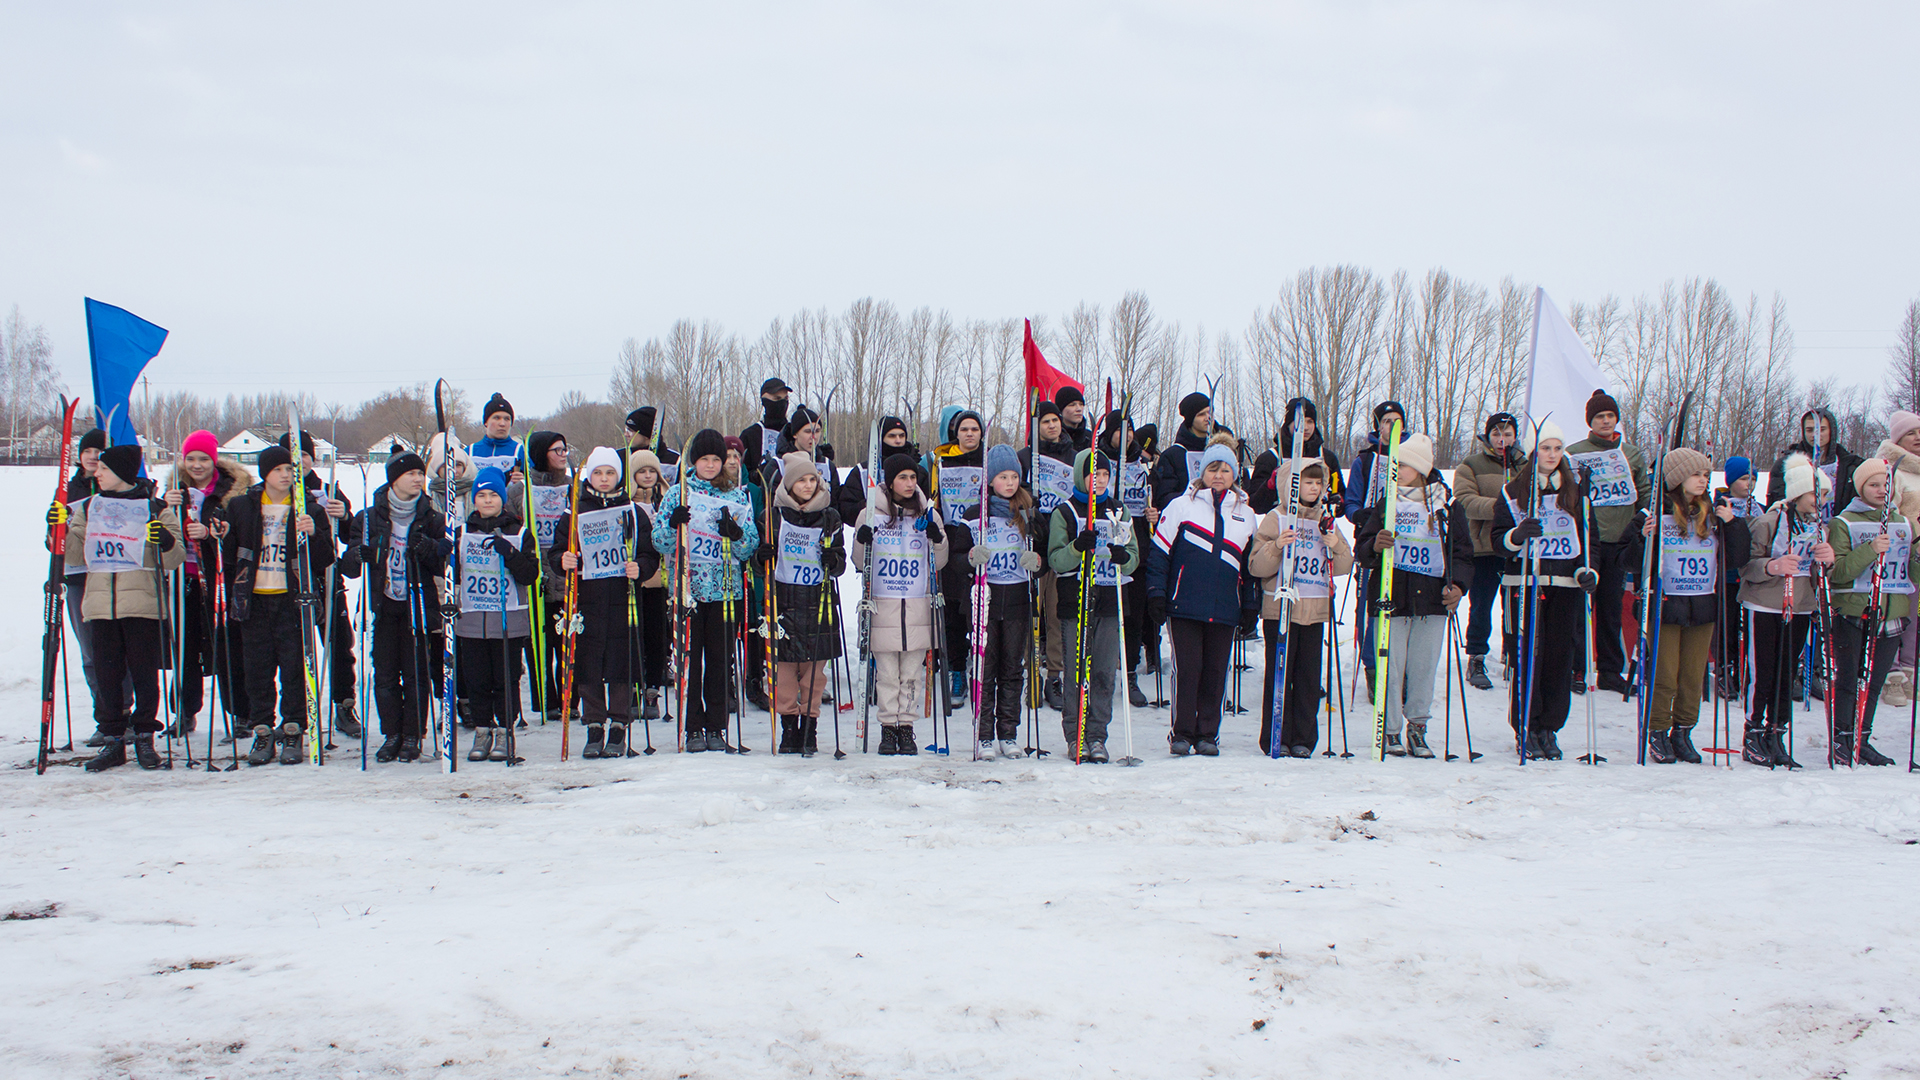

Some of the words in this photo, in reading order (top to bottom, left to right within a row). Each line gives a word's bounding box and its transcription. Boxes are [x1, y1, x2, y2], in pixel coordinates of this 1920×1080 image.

[1591, 481, 1630, 501] 2548
[582, 520, 608, 530] ЛЫЖНЯ
[583, 526, 609, 536] РОССИИ
[583, 533, 610, 545] 2020
[785, 531, 810, 540] ЛЫЖНЯ
[785, 538, 809, 546] РОССИИ
[877, 537, 901, 545] 2023
[260, 544, 287, 563] 1375
[466, 548, 492, 556] РОССИИ
[592, 546, 627, 568] 1300
[784, 545, 806, 554] 2021
[1400, 545, 1430, 565] 798
[877, 558, 919, 578] 2068
[987, 552, 1017, 570] 413
[1677, 557, 1709, 576] 793
[793, 565, 820, 585] 782
[467, 575, 510, 595] 2632
[1375, 711, 1384, 749] ACTIVE
